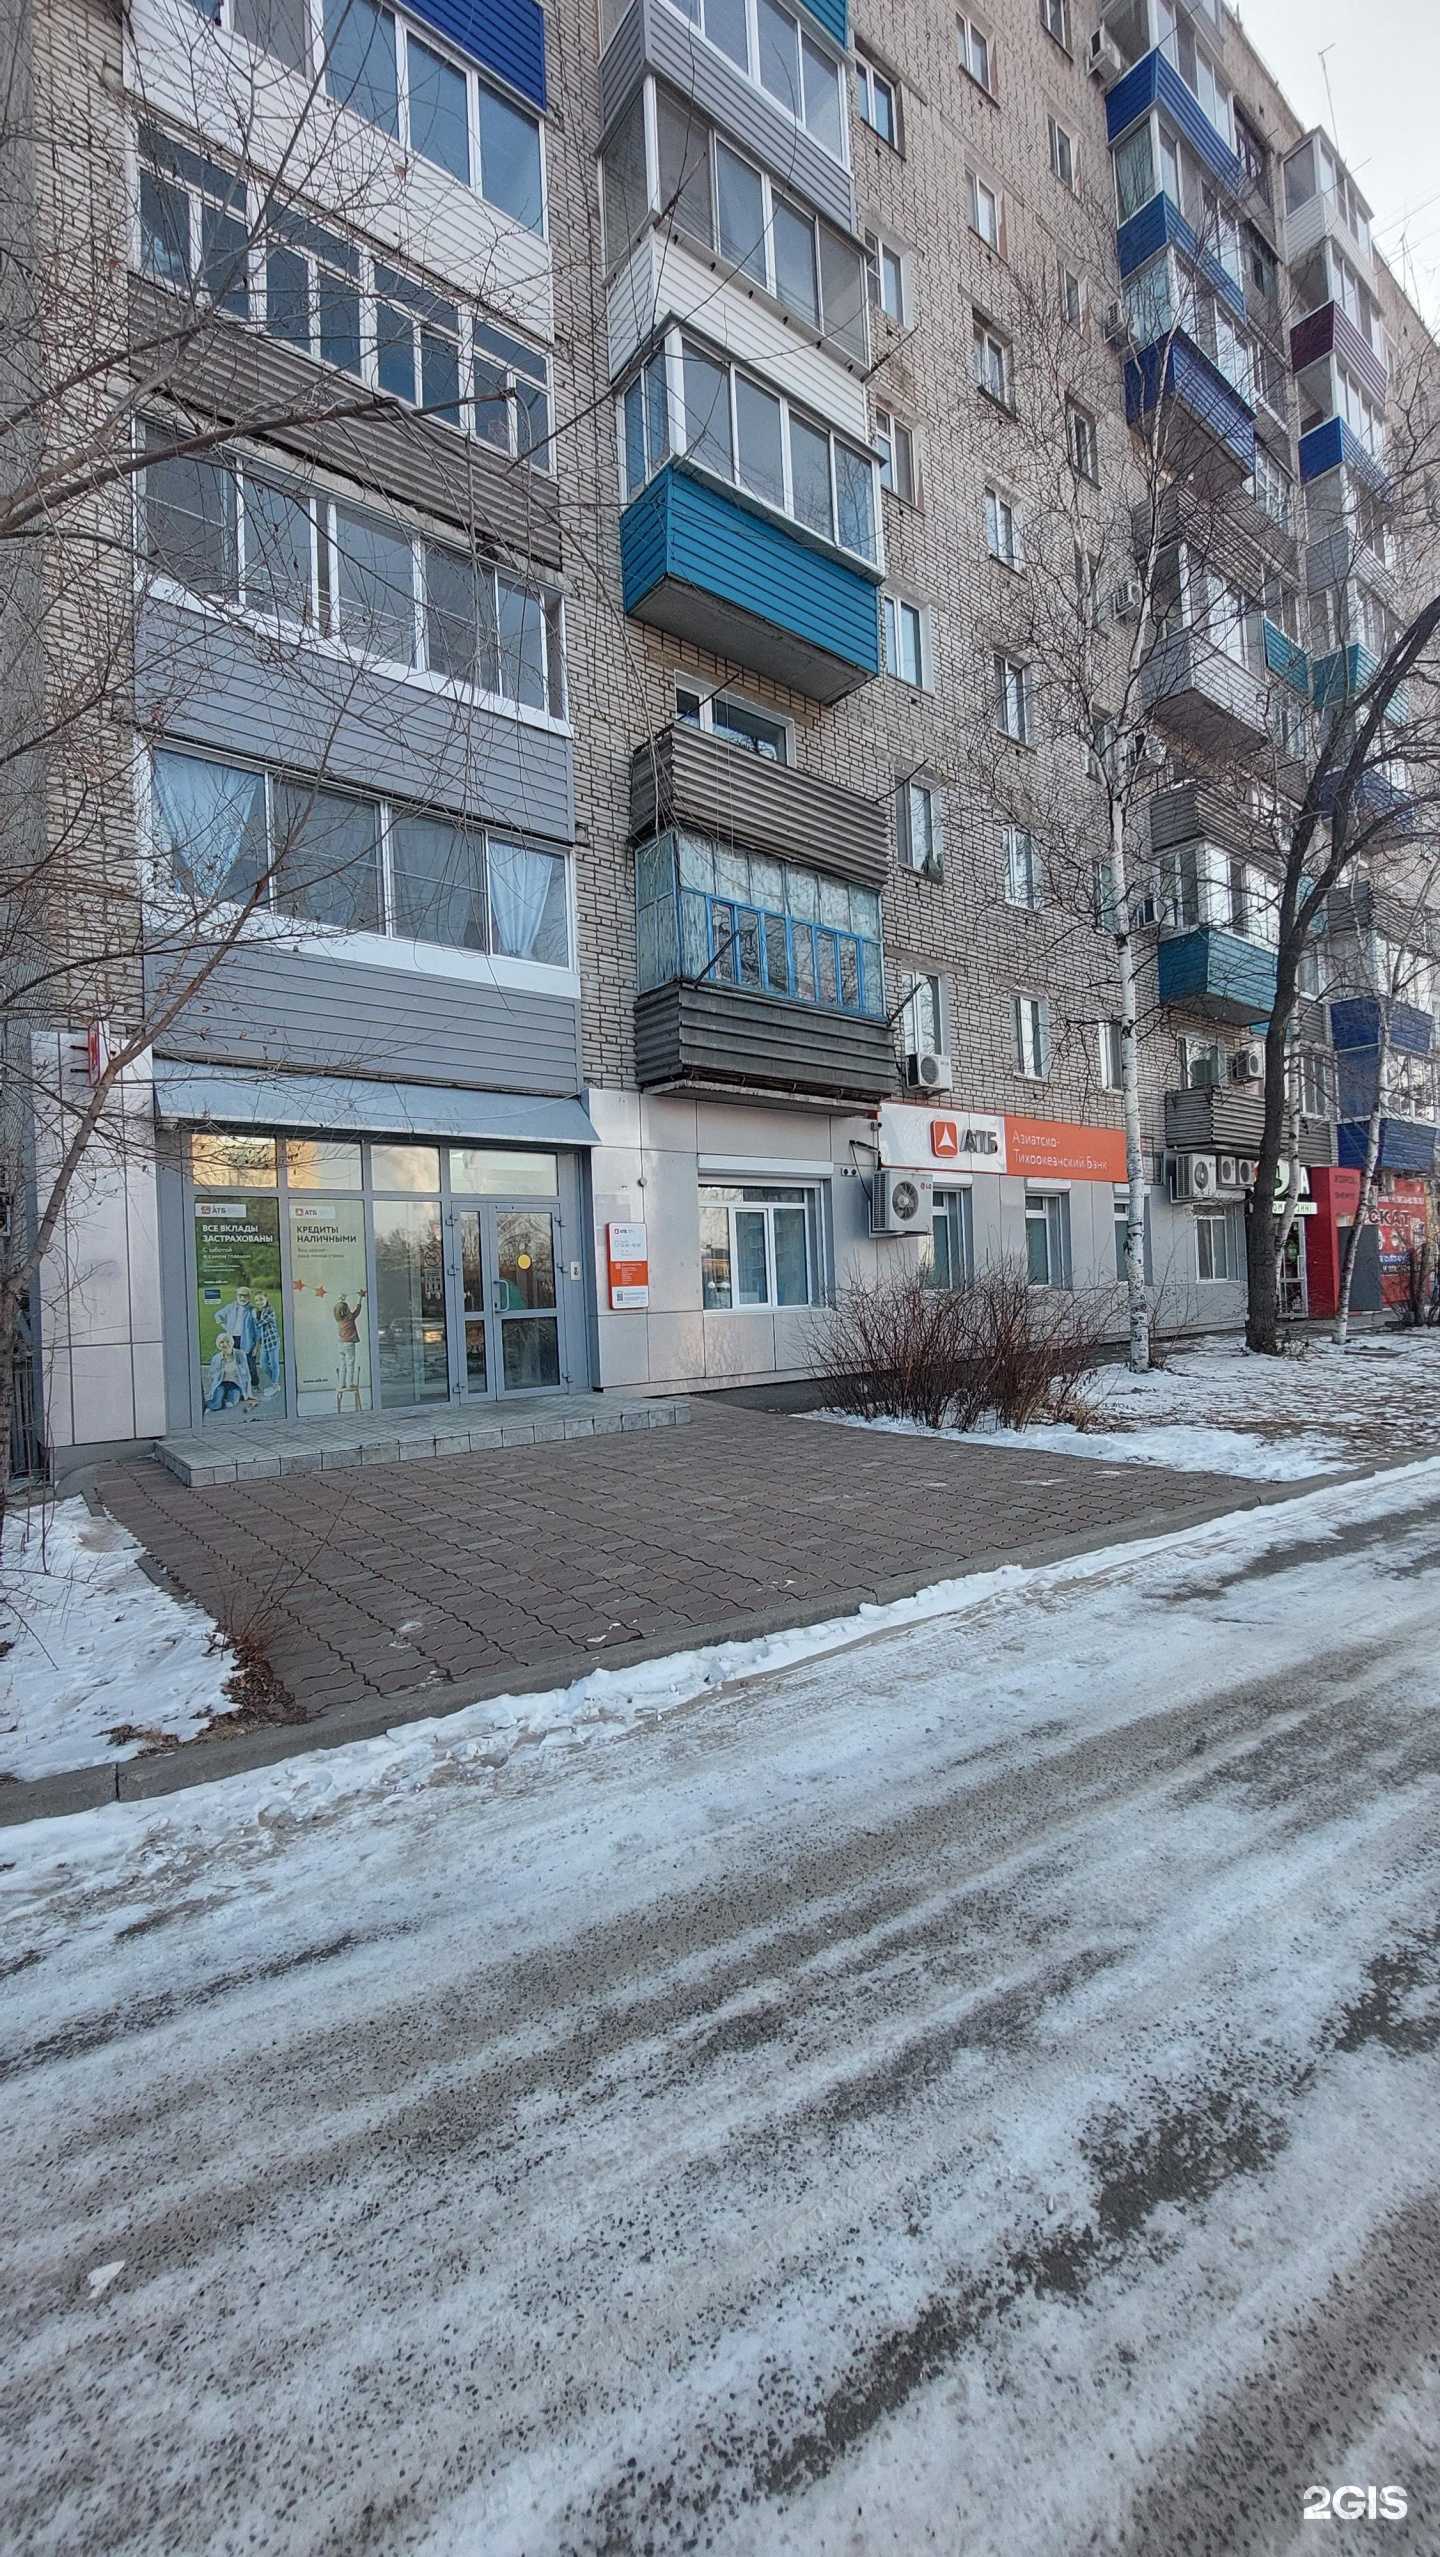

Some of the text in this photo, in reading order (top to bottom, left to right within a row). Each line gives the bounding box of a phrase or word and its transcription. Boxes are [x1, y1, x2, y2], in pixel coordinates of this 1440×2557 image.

[960, 1128, 998, 1155] АТБ
[1011, 1130, 1060, 1148] Азиатско-
[1013, 1148, 1109, 1171] Тихоокеанский Банк
[202, 1224, 259, 1234] ВСЕ ВКЛАДЫ
[296, 1225, 339, 1235] КРЕДИТЫ
[202, 1234, 273, 1243] ЗАСТРАХОВАНЫ
[296, 1234, 357, 1244] НАЛИЧНЫМИ
